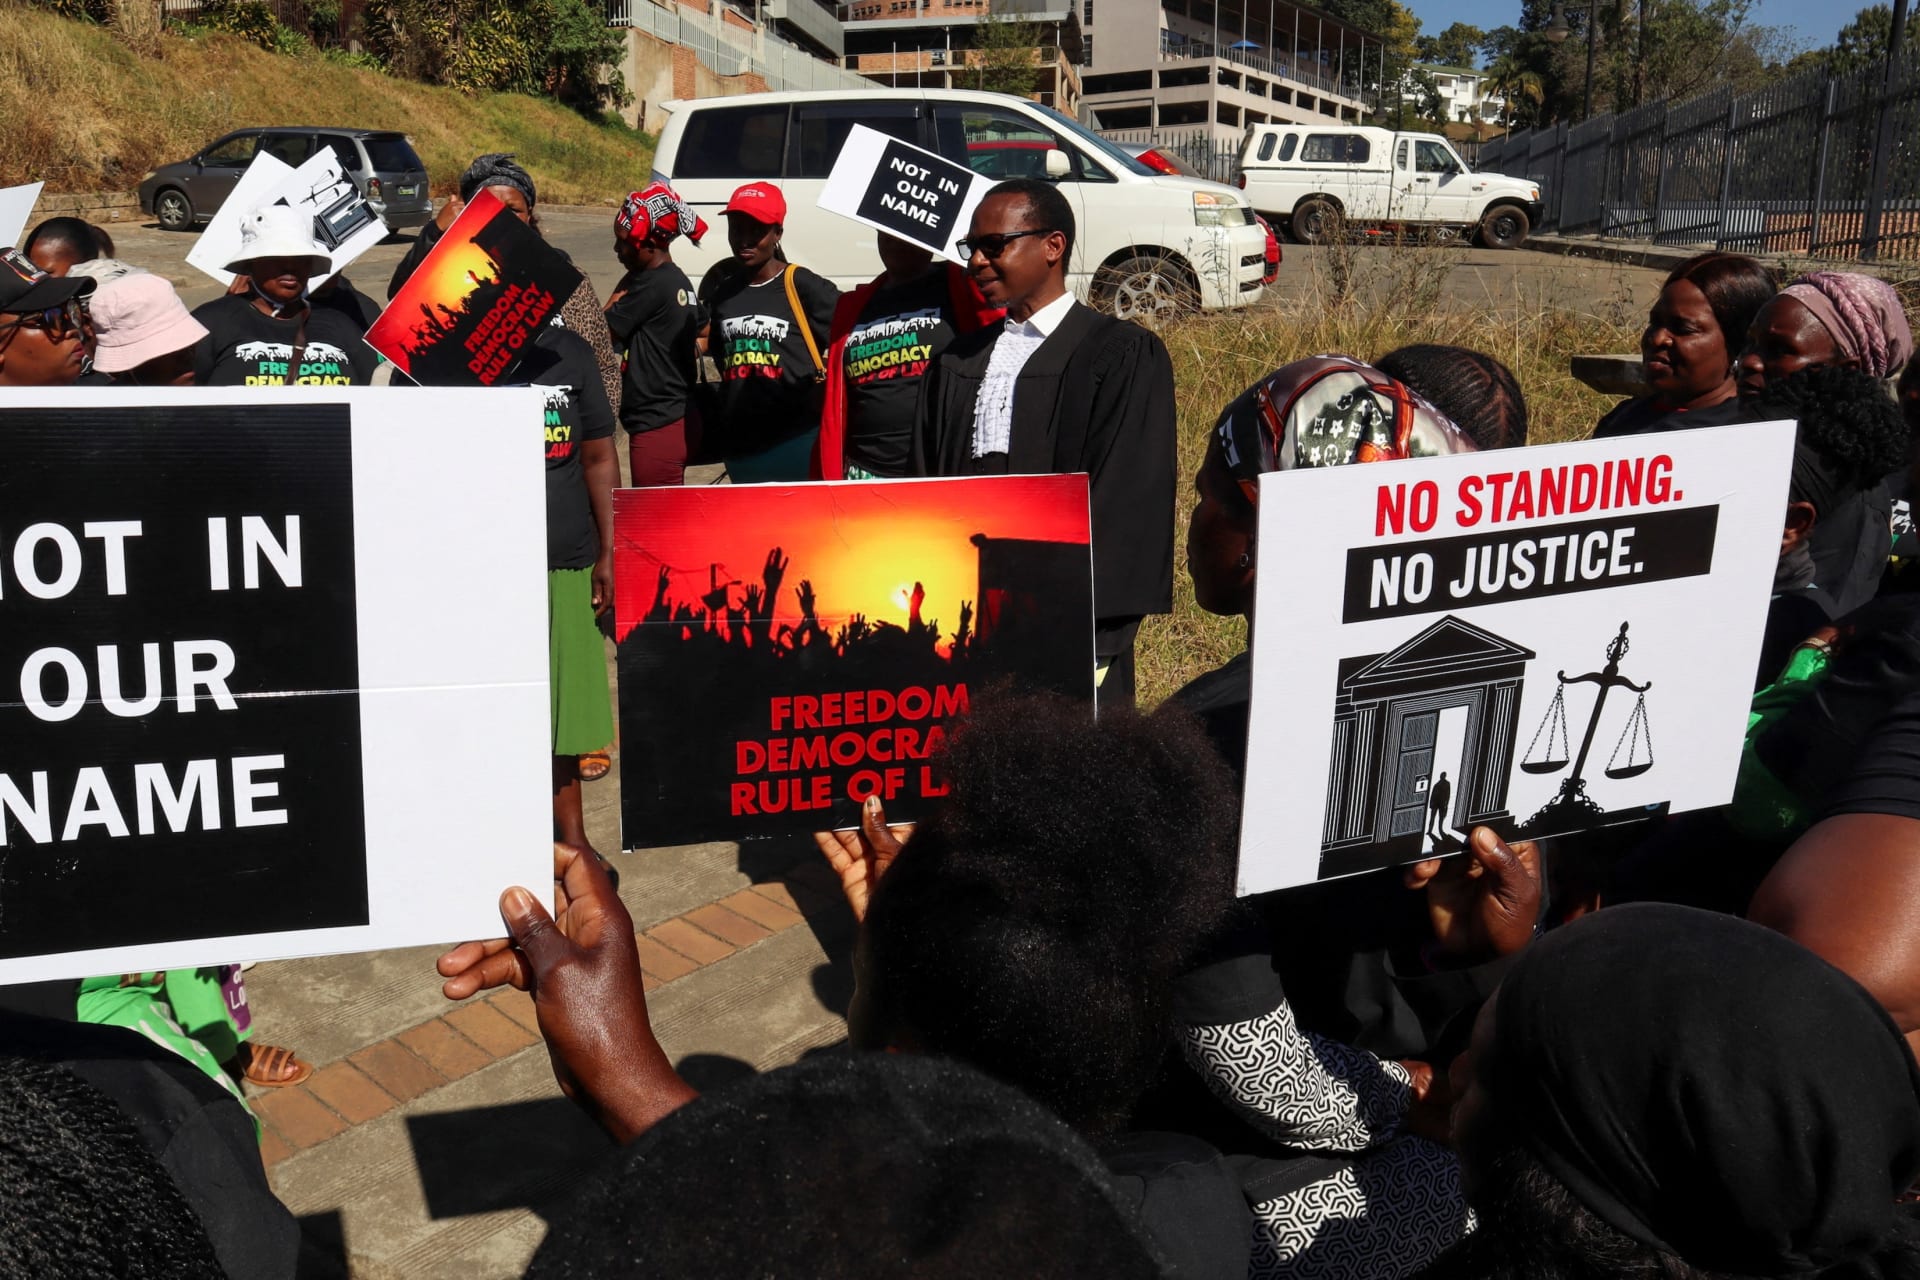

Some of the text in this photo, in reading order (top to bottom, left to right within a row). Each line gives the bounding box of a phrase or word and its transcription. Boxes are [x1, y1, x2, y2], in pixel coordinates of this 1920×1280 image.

[890, 157, 959, 196] NOT IN
[896, 180, 939, 207] OUR
[880, 193, 941, 229] NAME
[464, 283, 523, 353] FREEDOM
[468, 281, 541, 374] DEMOCRACY
[479, 291, 555, 386] RULE OF LAW
[259, 361, 340, 375] FREDOM
[845, 345, 932, 378] DEMOCRACY
[850, 332, 918, 361] FREEDOM
[245, 376, 350, 386] DEMCRACY
[1375, 454, 1684, 537] NO STANDING.
[0, 514, 303, 600] OT IN
[1369, 527, 1644, 609] NO JUSTICE.
[19, 638, 239, 722] OUR
[770, 683, 970, 731] FREEDOM
[0, 753, 289, 847] NAME
[730, 775, 832, 817] RULE
[846, 768, 906, 805] OF
